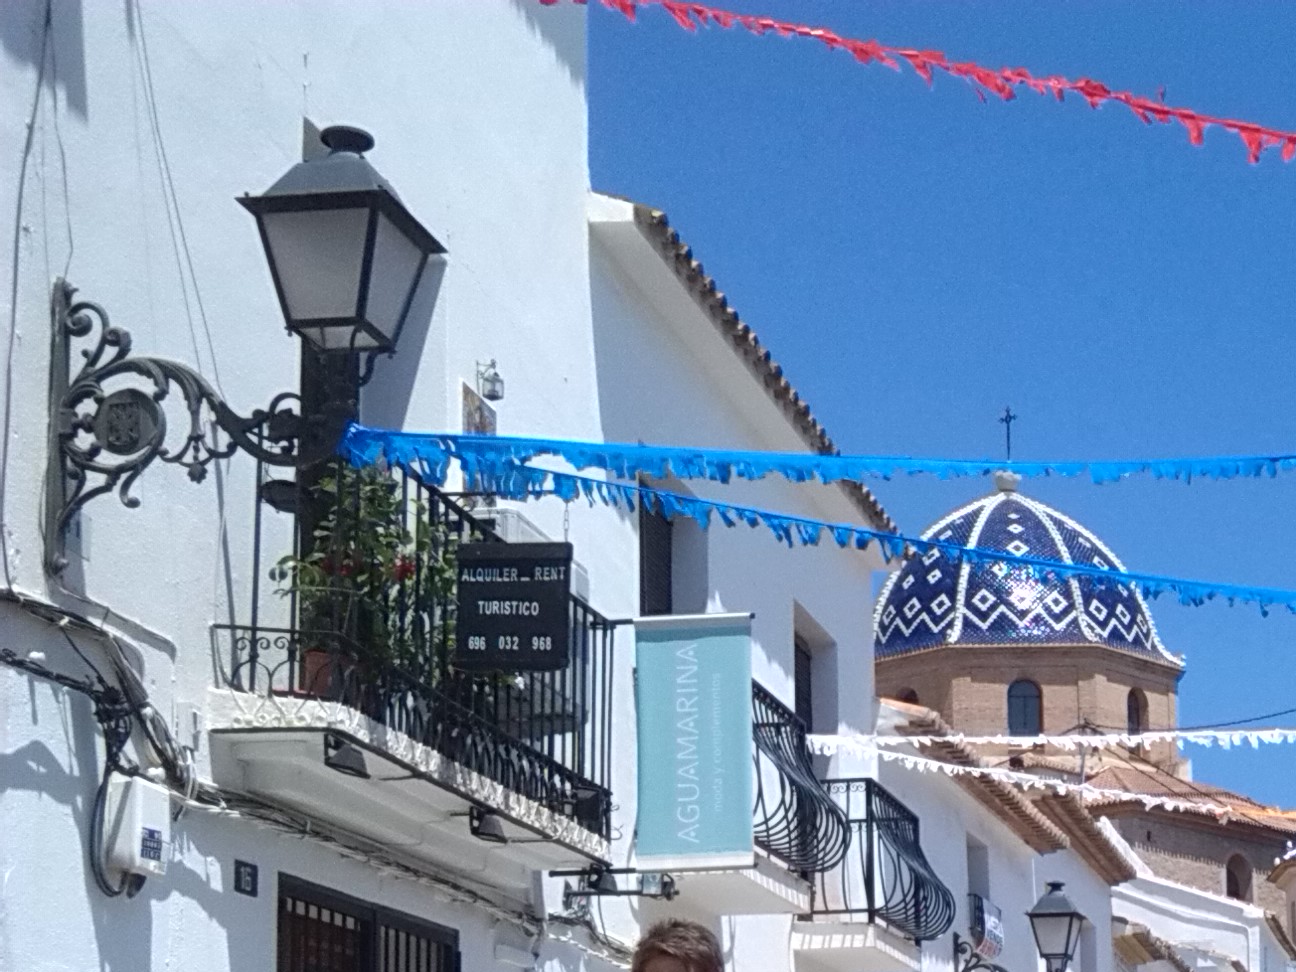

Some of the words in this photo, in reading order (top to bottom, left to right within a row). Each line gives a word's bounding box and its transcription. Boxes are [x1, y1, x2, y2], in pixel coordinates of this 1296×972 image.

[461, 567, 518, 582] ALQUILER
[534, 566, 567, 580] RENT
[477, 600, 540, 616] TURISTICO
[467, 636, 486, 651] 696
[498, 635, 519, 650] 032
[531, 636, 552, 651] 968
[710, 672, 725, 765] complementos
[676, 642, 700, 844] AGUAMARINA
[713, 766, 726, 775] y
[711, 777, 724, 813] moda
